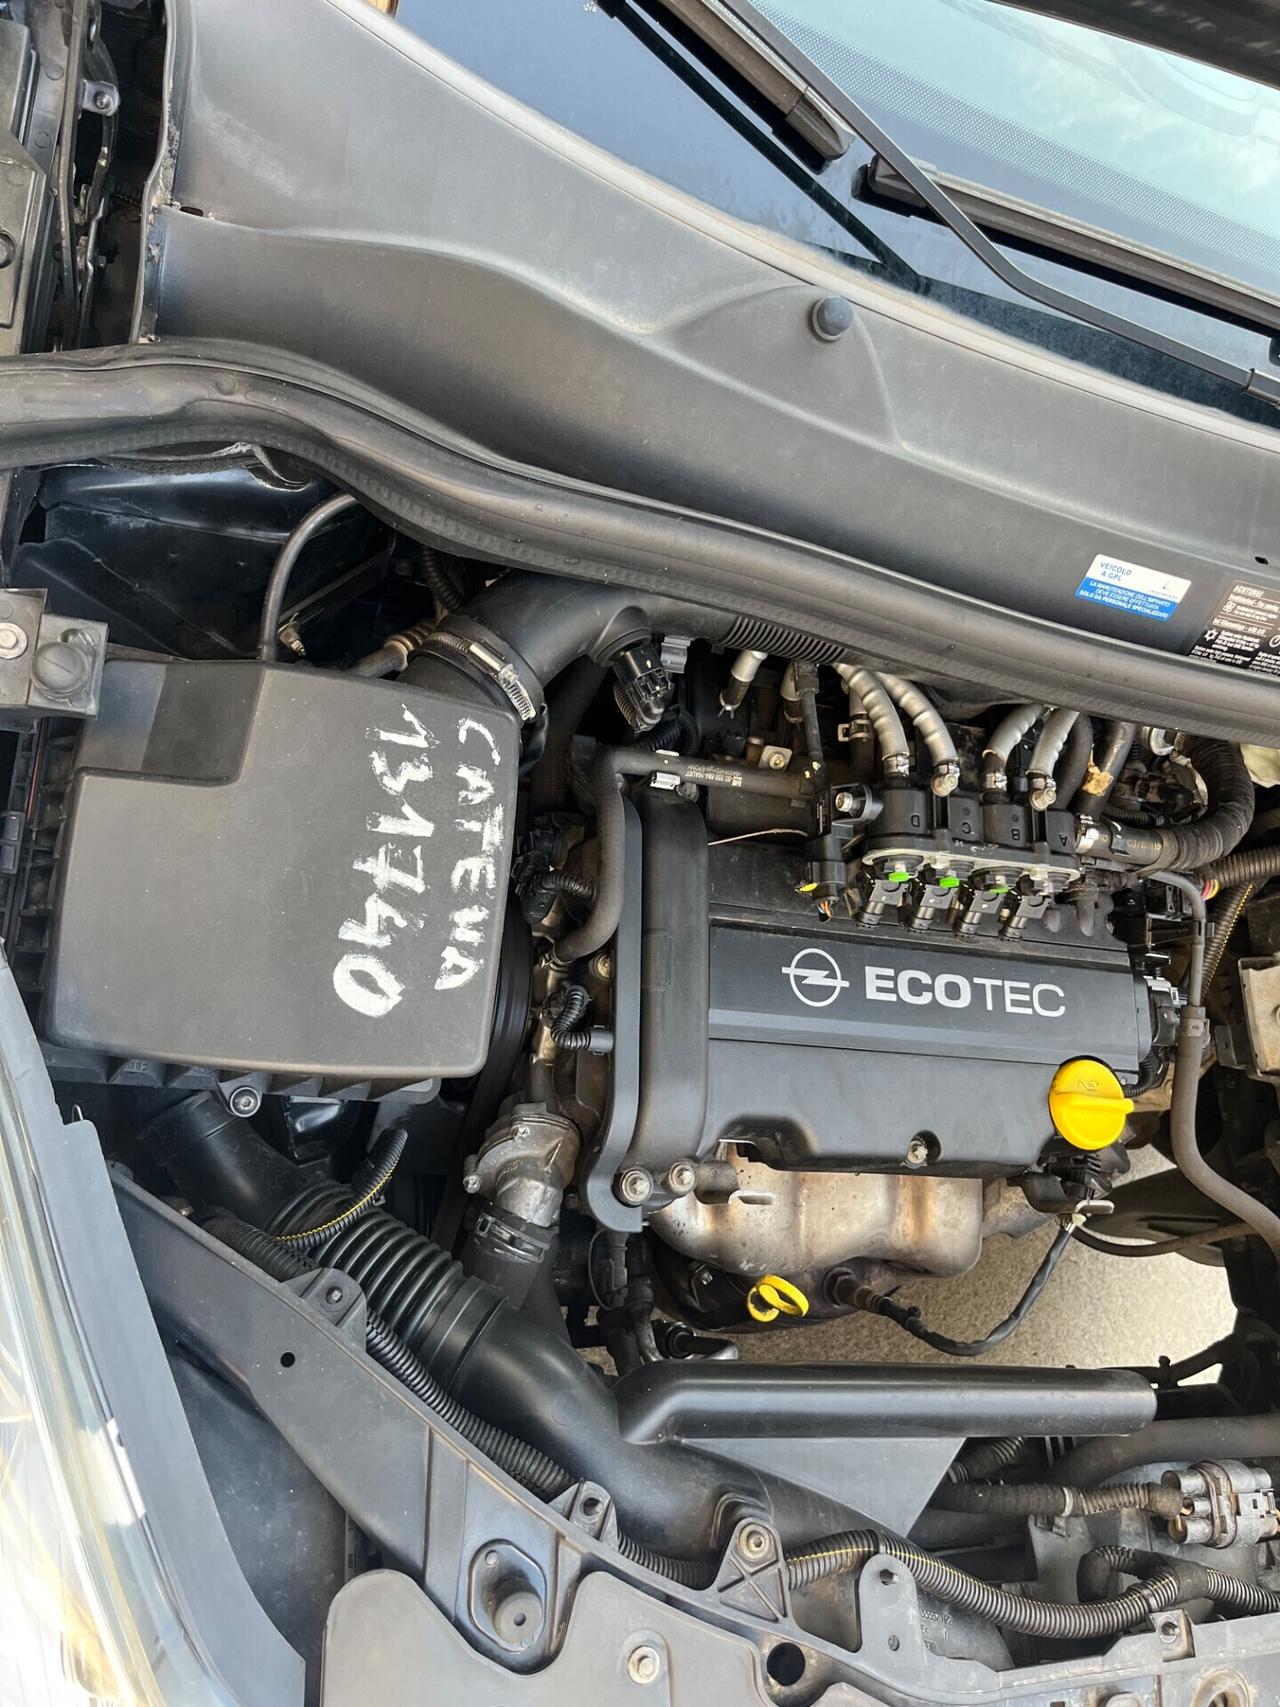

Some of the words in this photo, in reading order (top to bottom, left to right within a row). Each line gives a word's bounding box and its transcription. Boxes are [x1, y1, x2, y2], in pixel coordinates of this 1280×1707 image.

[1100, 561, 1132, 576] VEICOLO
[1107, 573, 1123, 582] GPL
[1011, 828, 1021, 841] B
[1058, 834, 1069, 847] A
[333, 703, 440, 1018] 131740
[864, 965, 1067, 1018] ECOTEC
